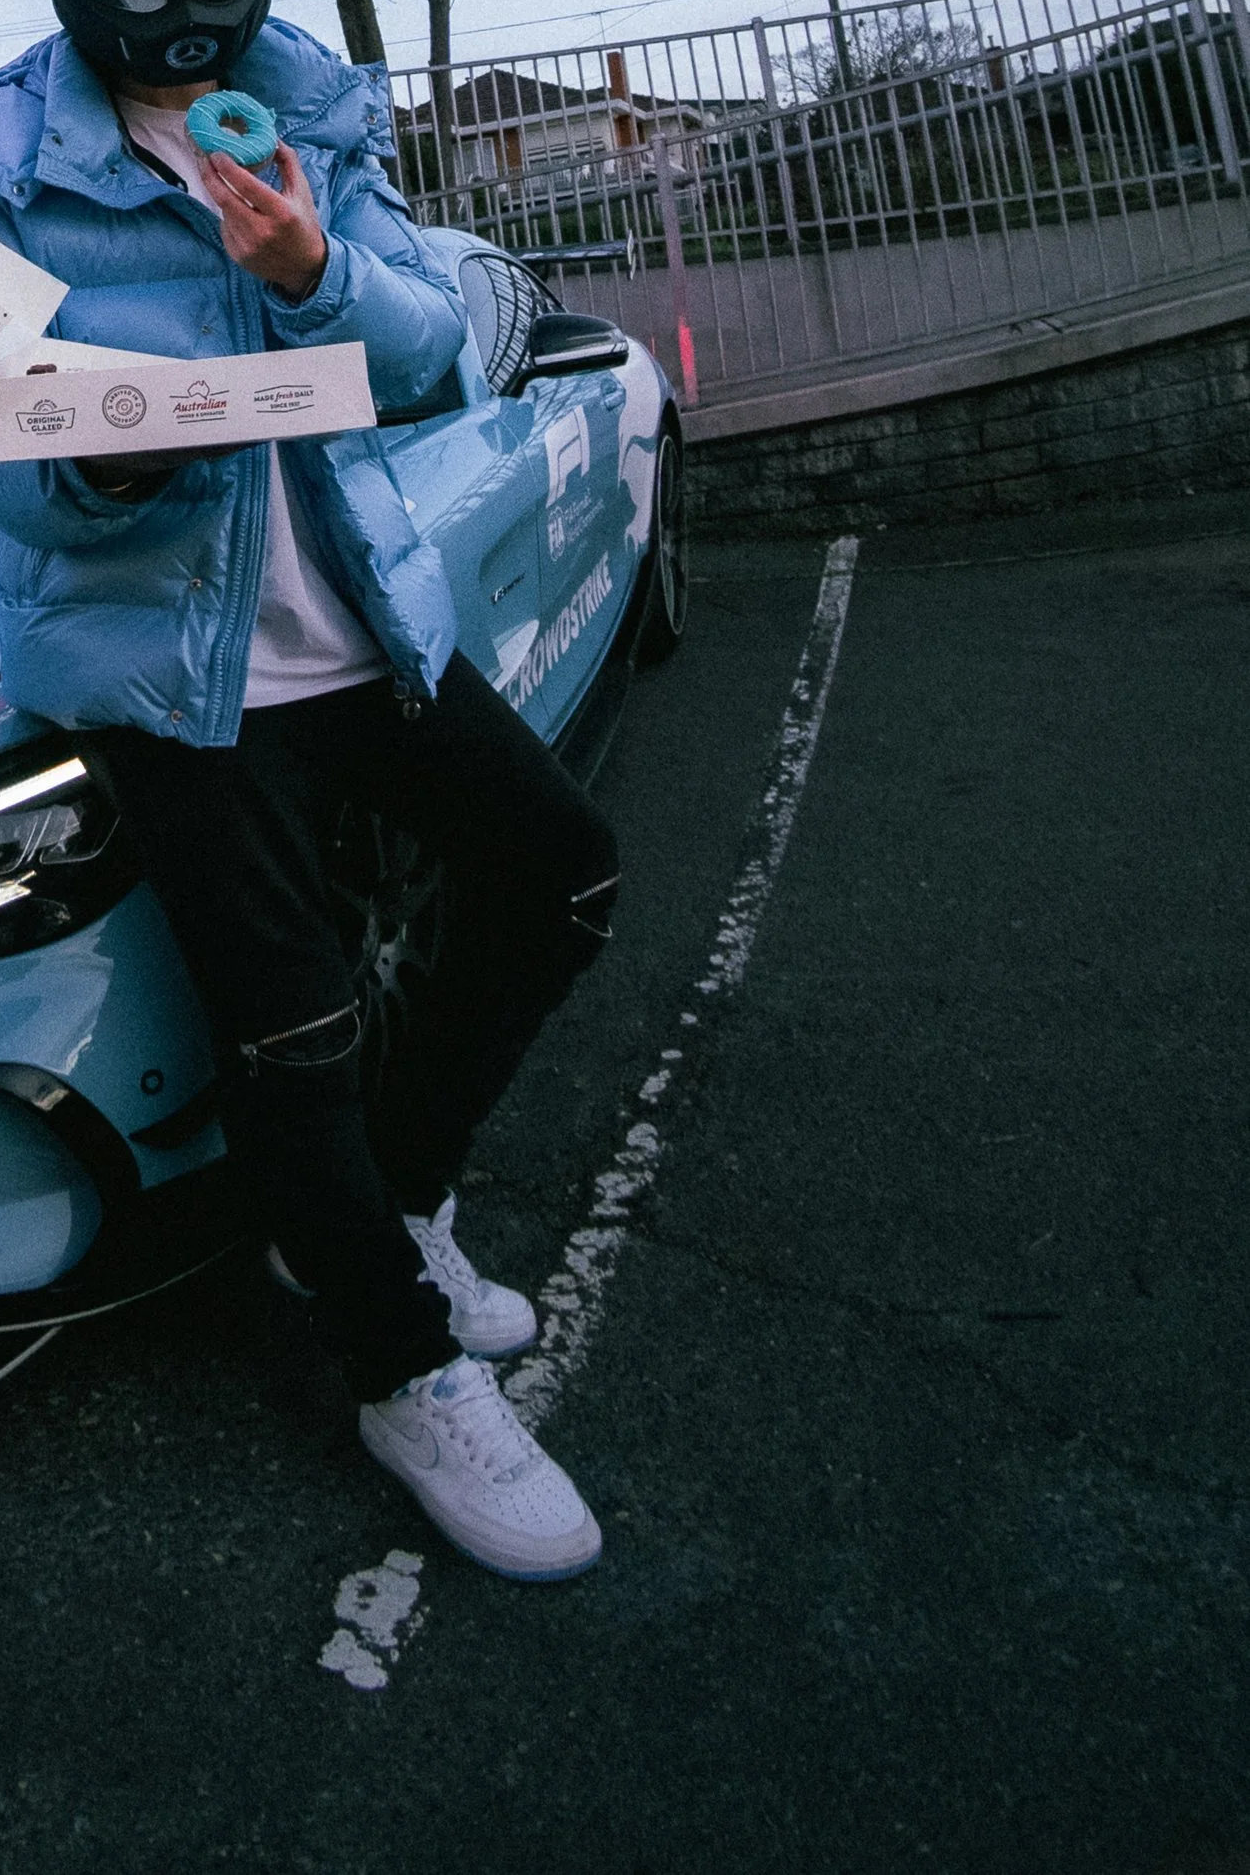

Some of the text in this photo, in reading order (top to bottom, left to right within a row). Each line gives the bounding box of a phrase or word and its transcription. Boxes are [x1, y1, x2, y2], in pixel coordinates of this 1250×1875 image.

[254, 390, 314, 403] MADE fresh DAILY
[172, 398, 227, 413] Australian
[26, 415, 66, 425] ORIGINAL
[31, 423, 63, 432] GLAZED
[506, 550, 613, 712] CROWDSTRIKE
